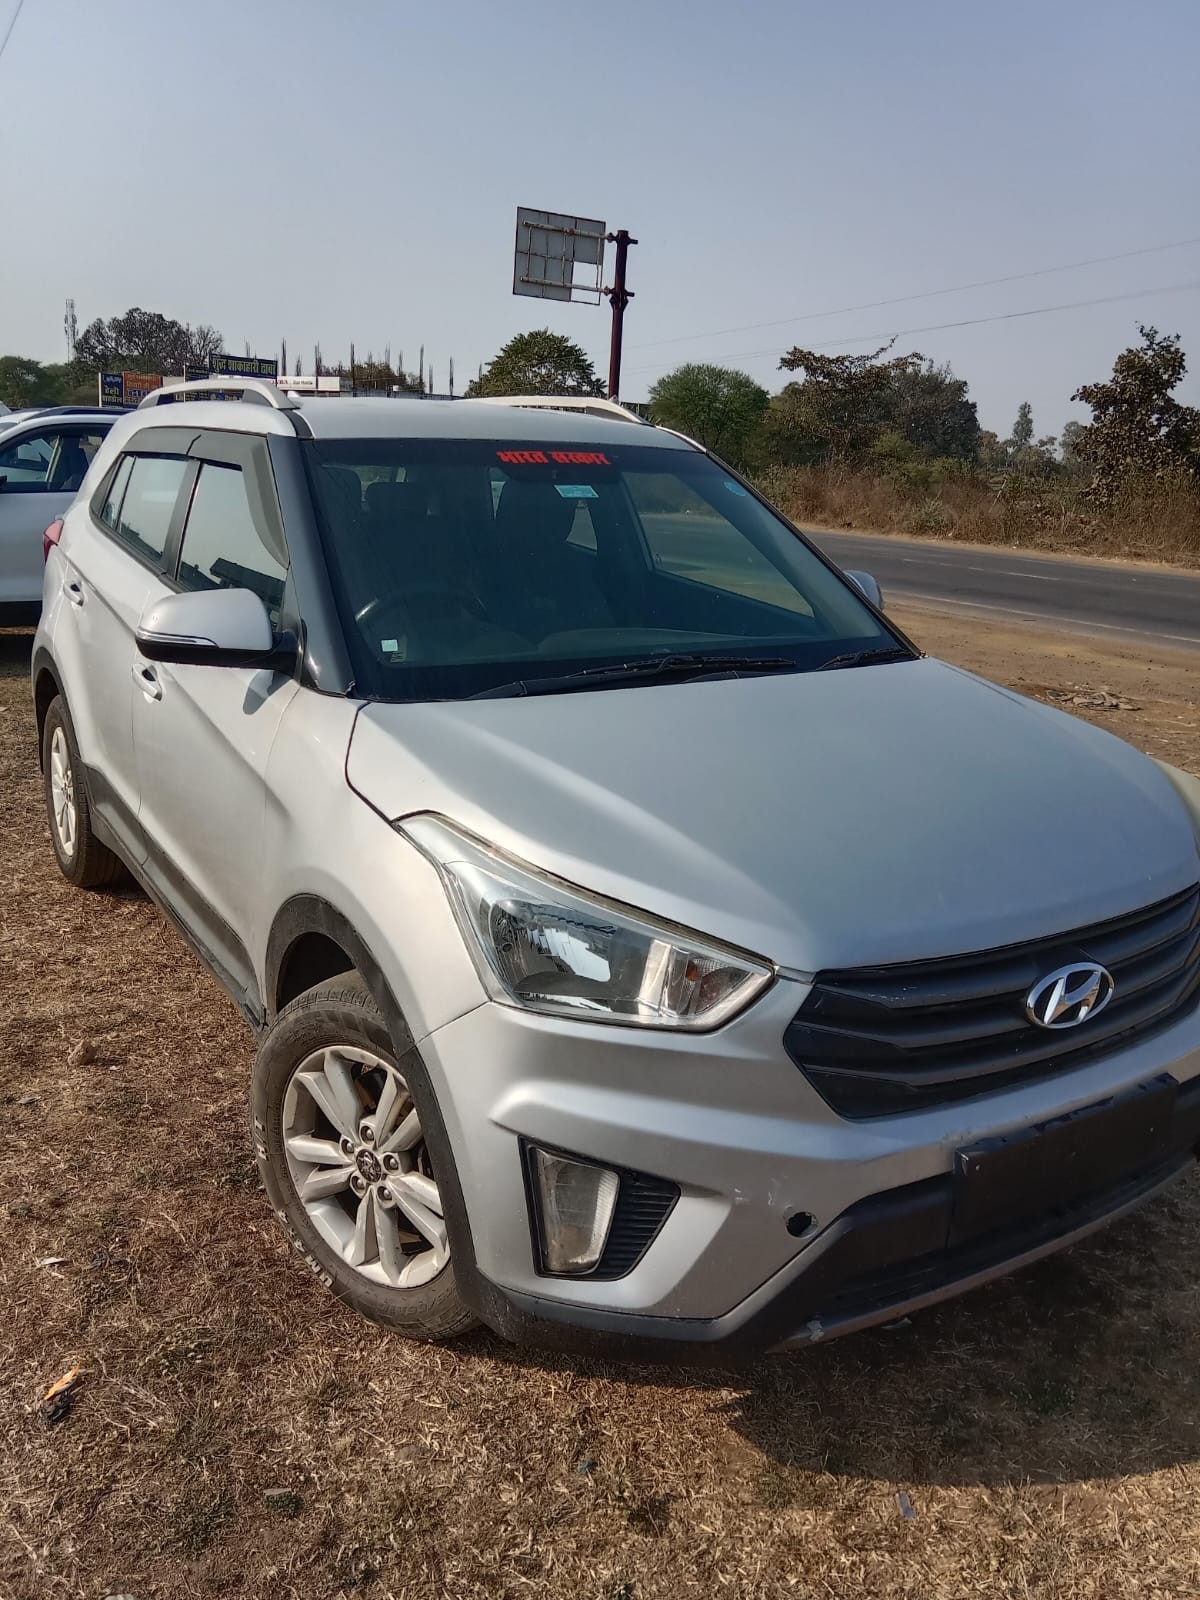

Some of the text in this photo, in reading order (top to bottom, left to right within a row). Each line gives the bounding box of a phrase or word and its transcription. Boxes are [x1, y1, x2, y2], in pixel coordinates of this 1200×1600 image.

[228, 360, 259, 373] शाकाहारी
[496, 451, 611, 464] भारत सरकार
